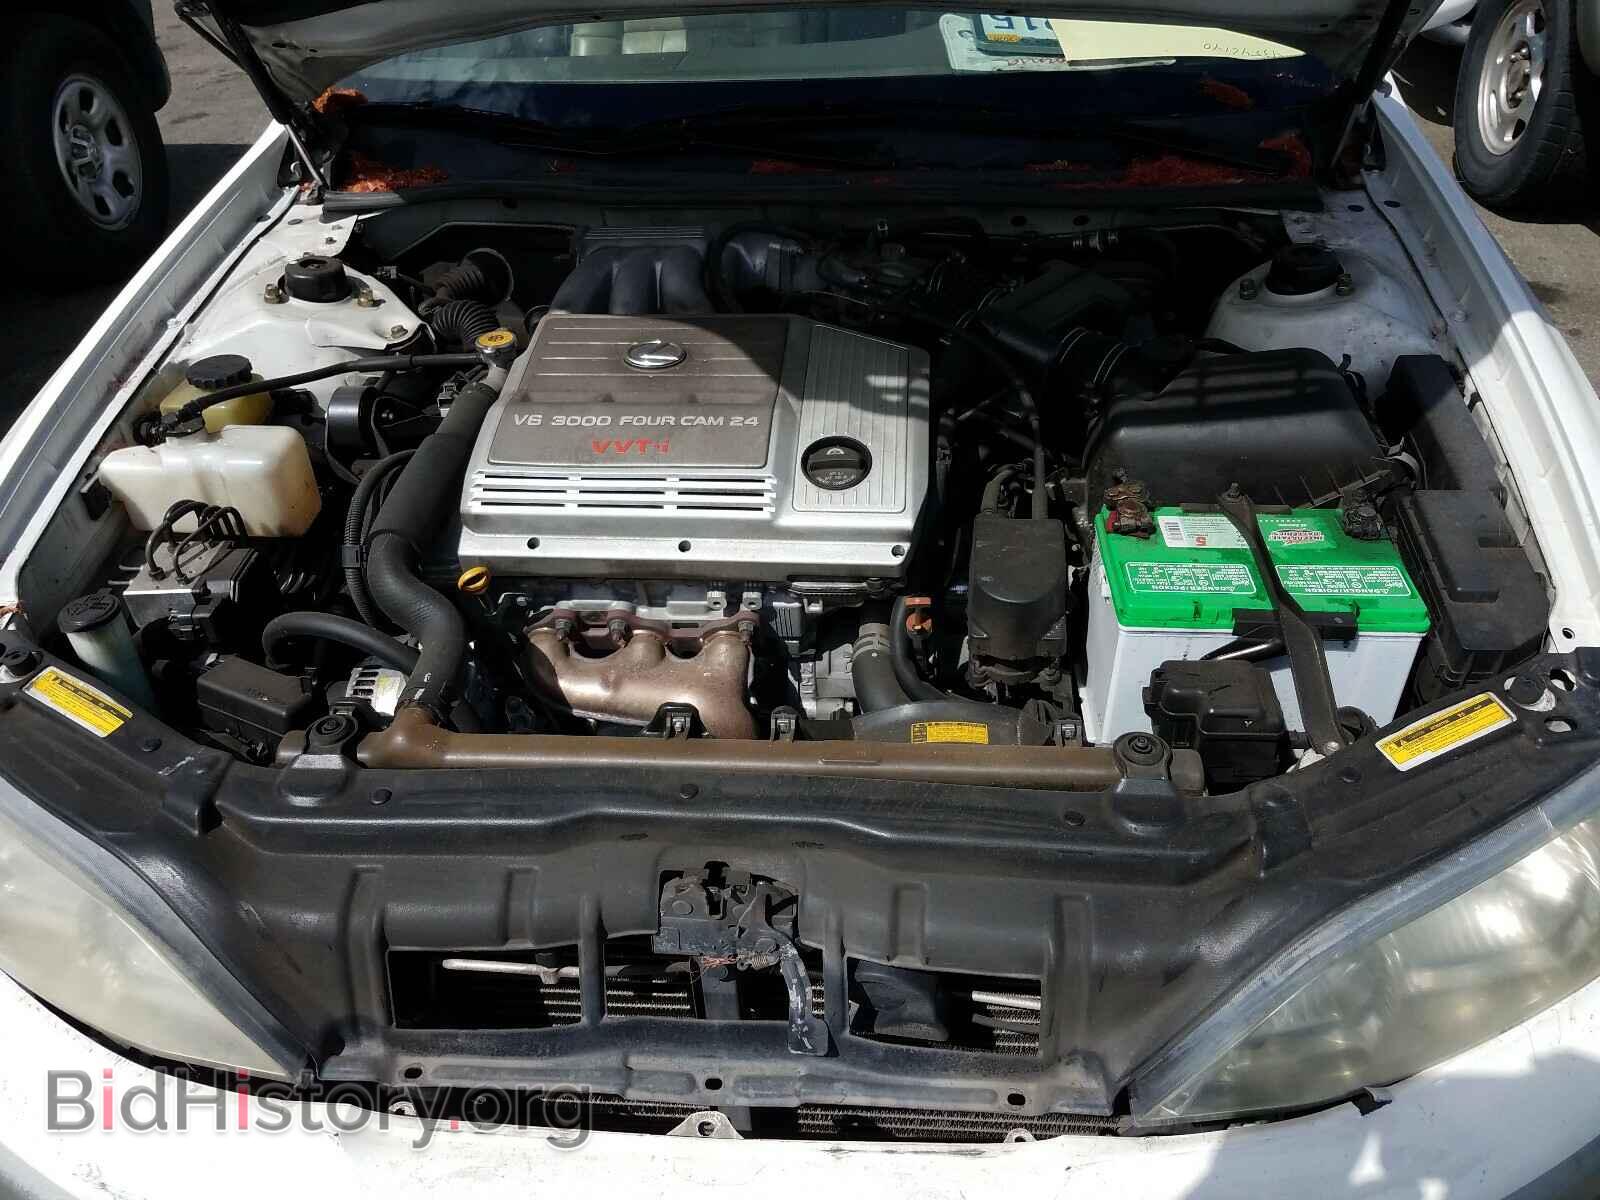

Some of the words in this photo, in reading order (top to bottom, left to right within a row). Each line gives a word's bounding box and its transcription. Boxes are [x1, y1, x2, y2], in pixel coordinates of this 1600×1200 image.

[513, 414, 542, 426] V6
[552, 415, 611, 426] 3000
[619, 415, 676, 426] FOUR
[680, 416, 724, 427] CAM
[729, 416, 760, 427] 24
